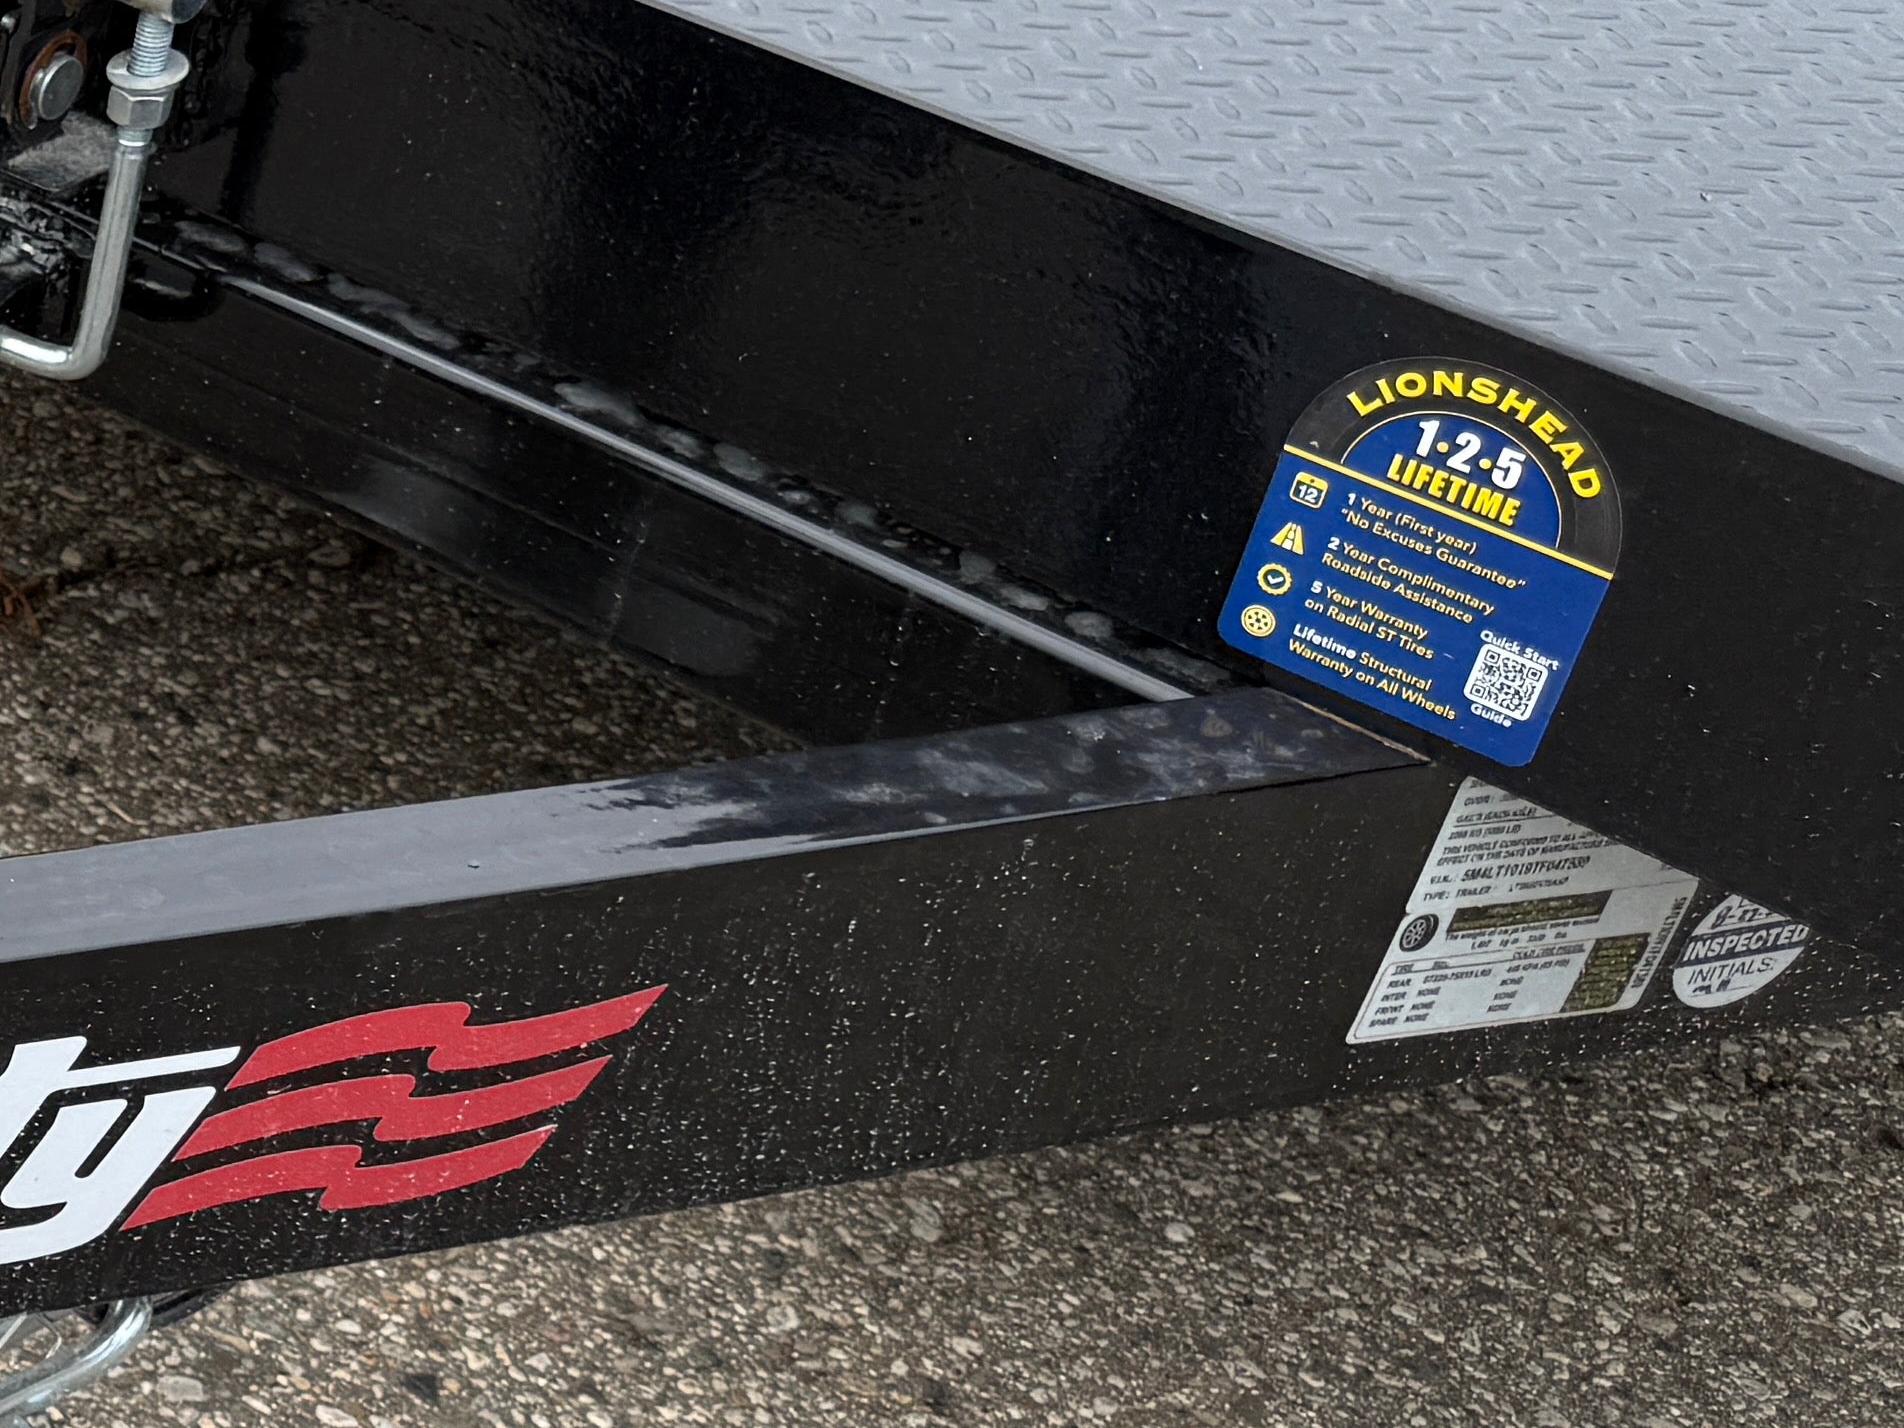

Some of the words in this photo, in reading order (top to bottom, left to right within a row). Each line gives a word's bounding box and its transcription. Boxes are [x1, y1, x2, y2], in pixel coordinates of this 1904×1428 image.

[1347, 369, 1602, 500] LIONSHEAD
[1296, 484, 1319, 503] 12
[1387, 453, 1521, 528] LIFETIME
[1346, 493, 1356, 506] 1
[1361, 497, 1393, 520] Year
[1395, 512, 1434, 538] (First
[1437, 530, 1478, 555] year)
[1373, 522, 1433, 555] Excuses
[1321, 552, 1392, 590] Roadside
[1393, 583, 1473, 624] Assistance
[1327, 536, 1340, 550] 2
[1343, 542, 1375, 564] Year
[1377, 558, 1495, 616] Complimentary
[1304, 598, 1324, 614] on
[1327, 606, 1375, 635] Radial
[1376, 628, 1396, 642] ST
[1399, 635, 1435, 660] Tires
[1310, 580, 1323, 594] 5
[1326, 585, 1358, 609] Year
[1361, 600, 1429, 640] Warranty
[1289, 639, 1354, 677] Warranty
[1355, 670, 1376, 687] on
[1376, 677, 1399, 696] All
[1401, 686, 1457, 721] Wheels
[1293, 623, 1357, 660] Lifetime
[1359, 651, 1433, 691] Structural
[1480, 629, 1521, 654] Quick
[1523, 646, 1560, 671] Start
[1470, 702, 1513, 728] Guide
[1682, 924, 1810, 961] INSPECTED
